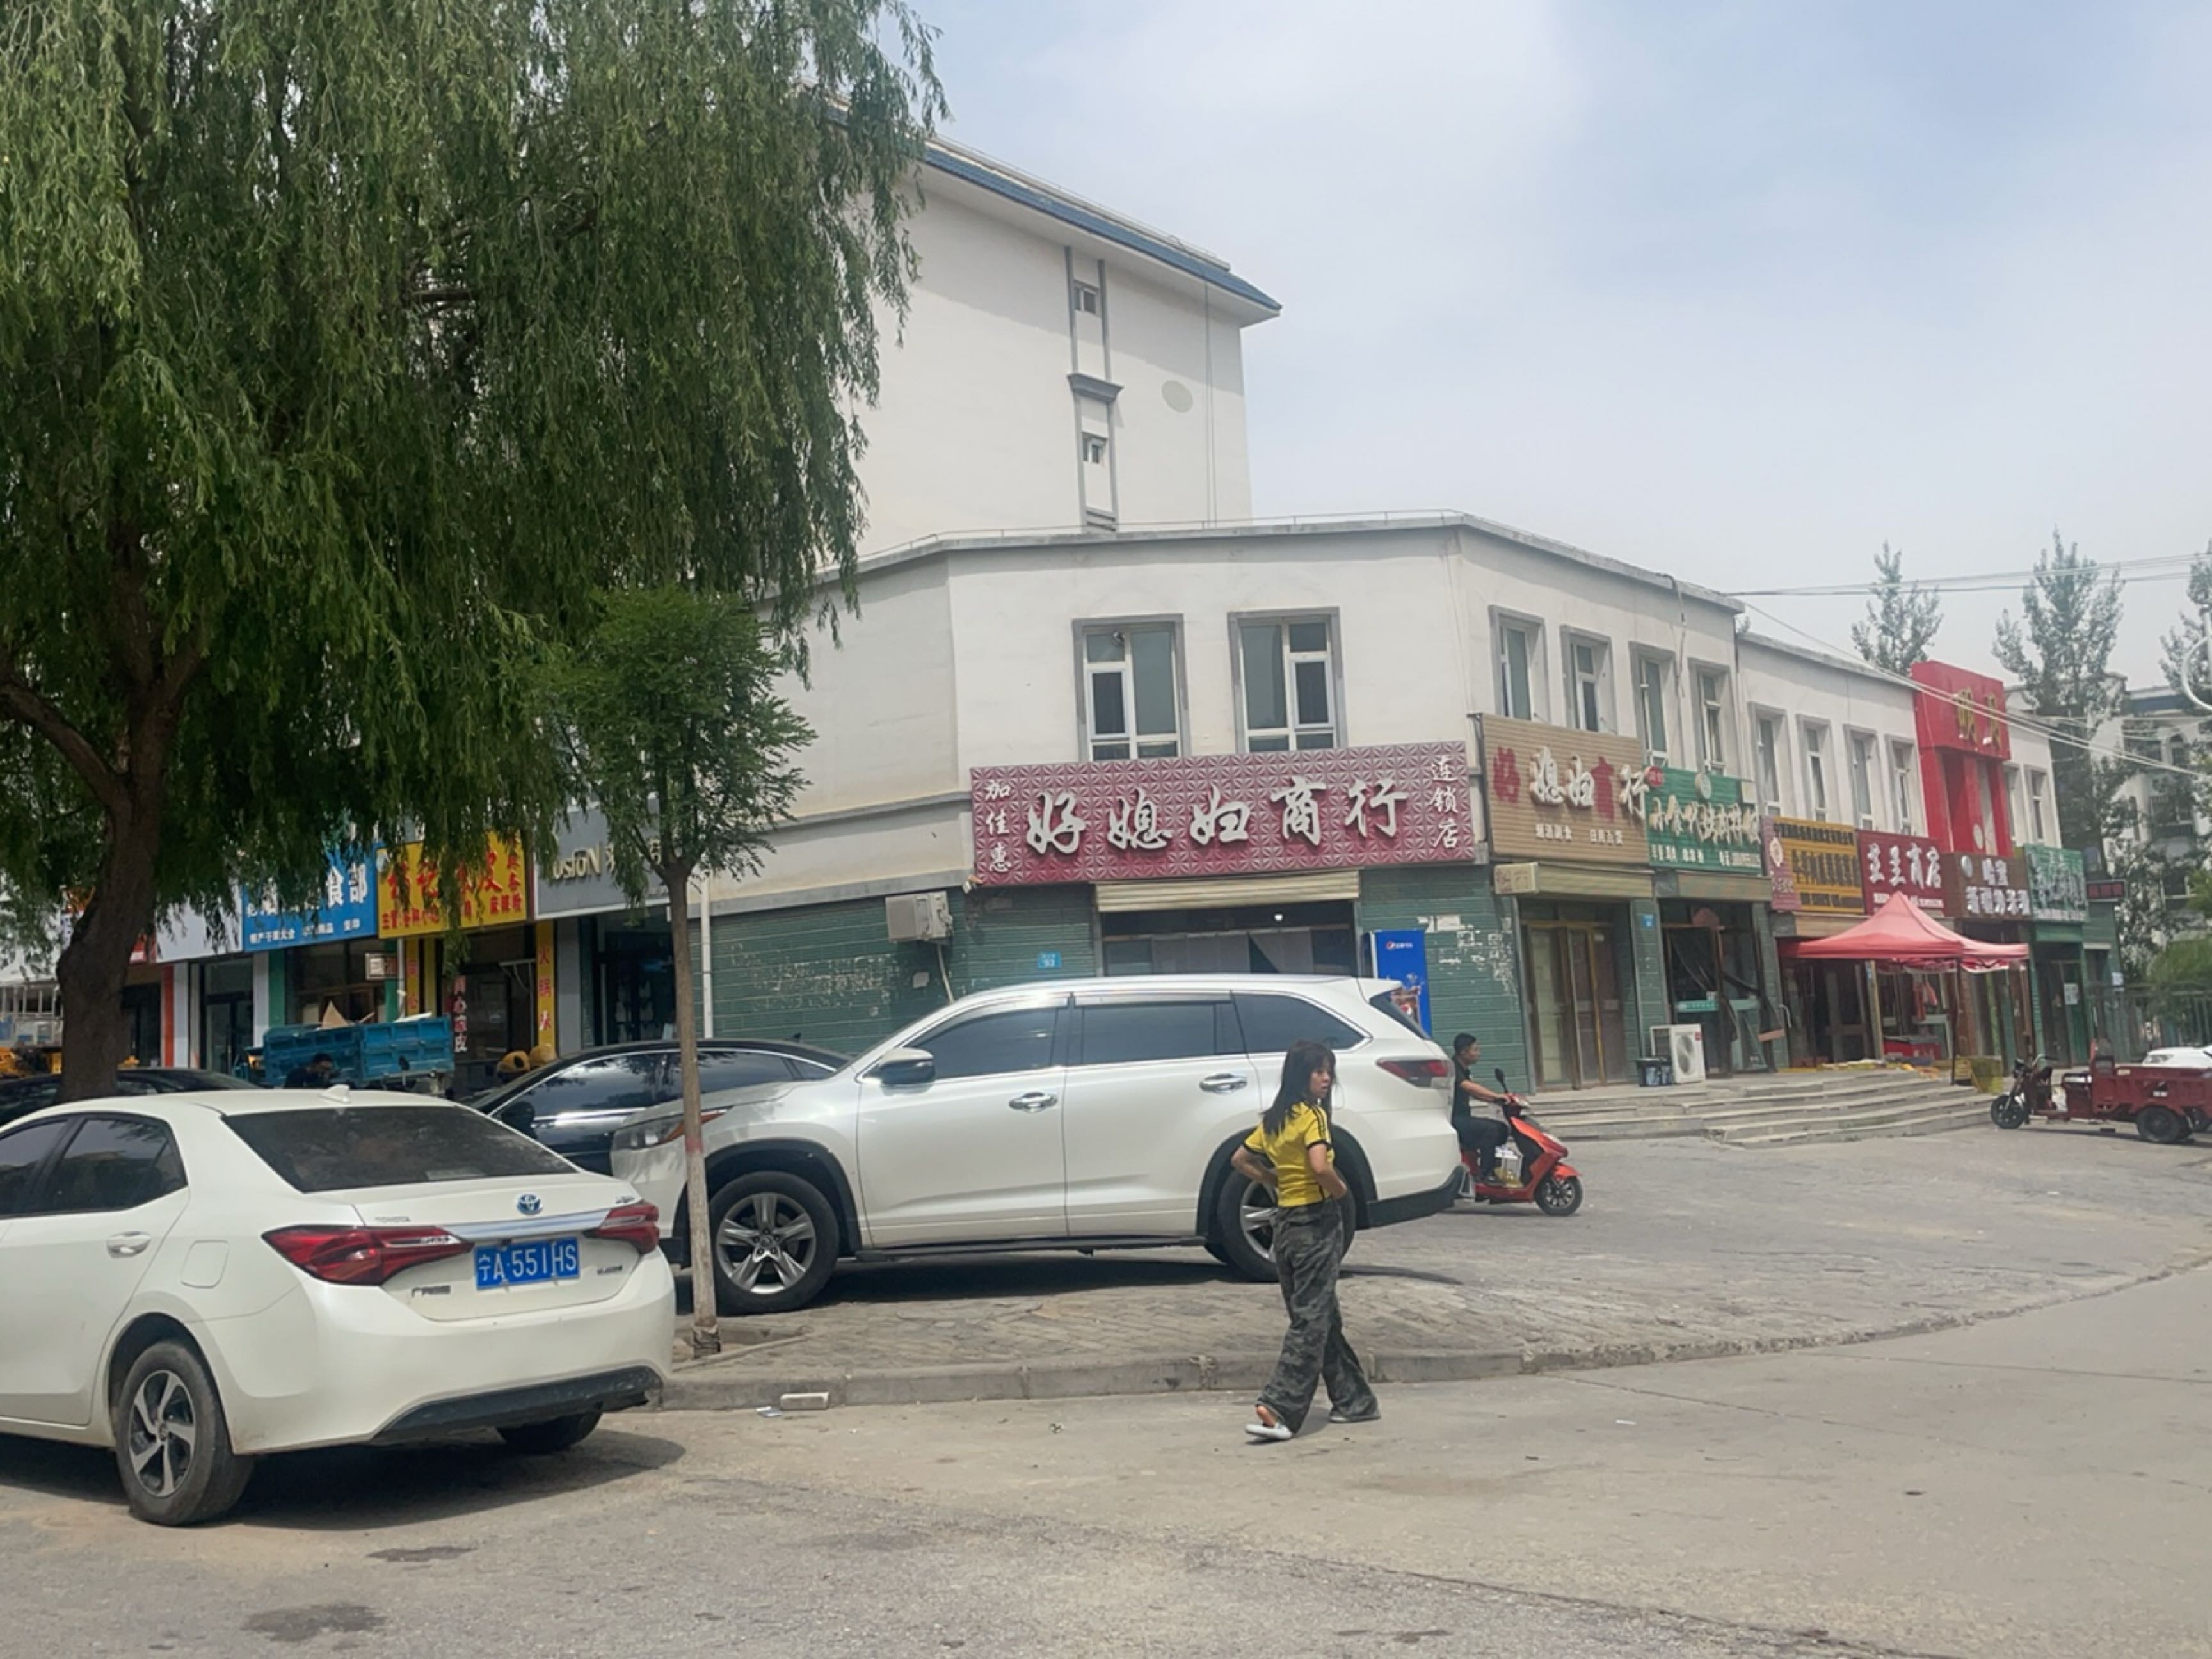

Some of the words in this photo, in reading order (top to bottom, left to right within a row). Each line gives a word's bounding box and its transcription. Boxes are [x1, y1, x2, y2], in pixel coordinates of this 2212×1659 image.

[984, 780, 1011, 872] 加佳惠
[1027, 777, 1408, 855] 好媳妇商行
